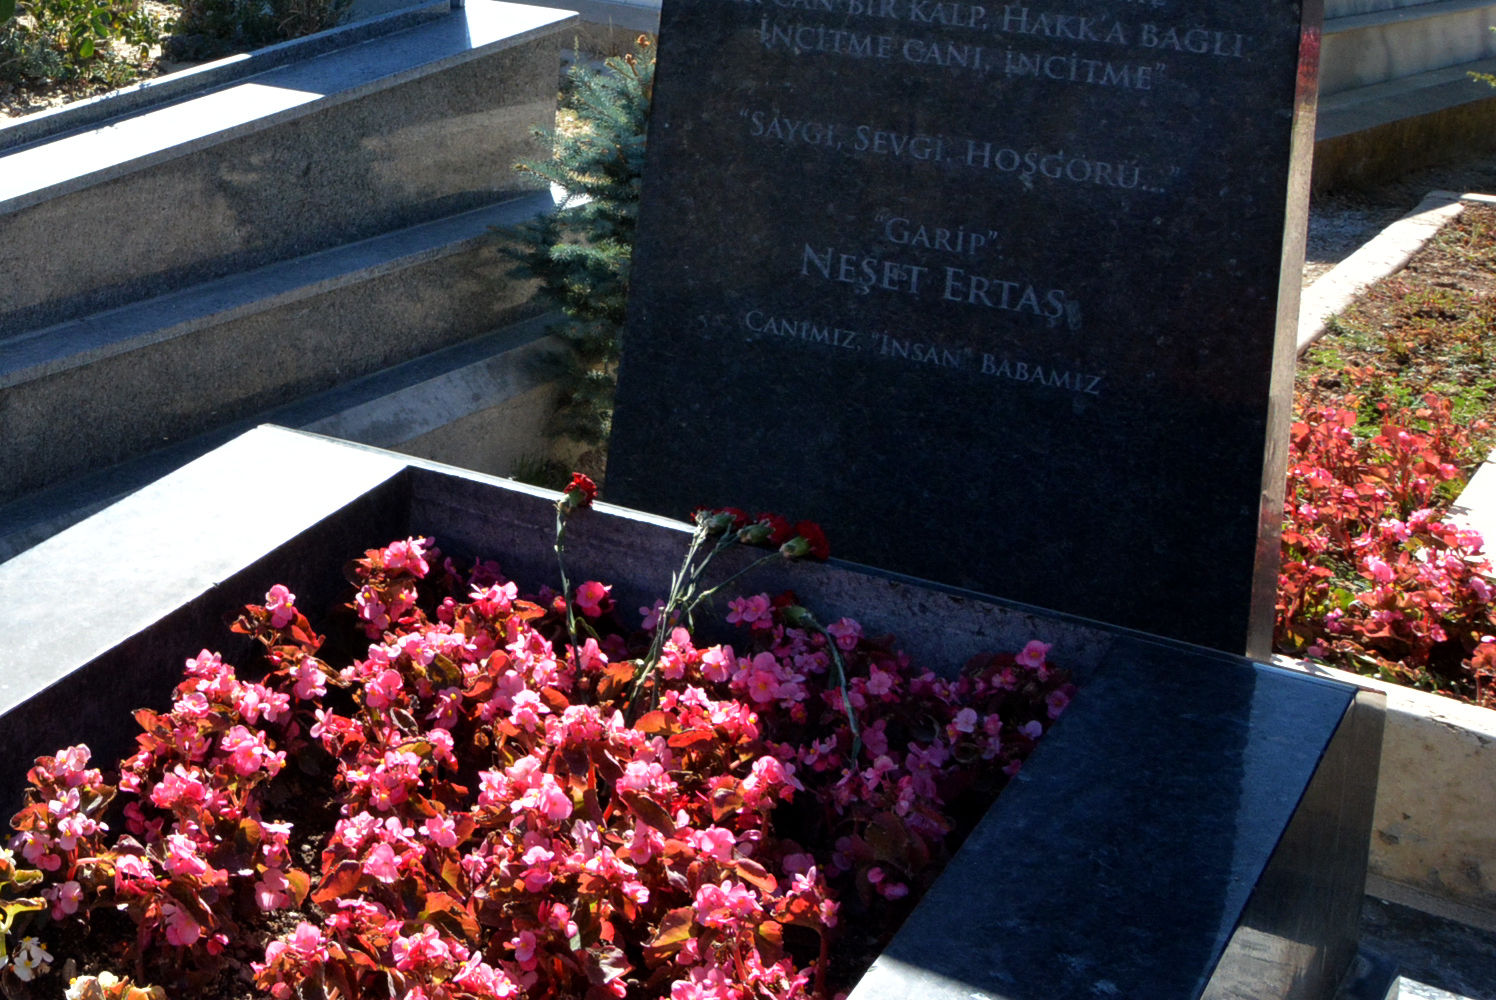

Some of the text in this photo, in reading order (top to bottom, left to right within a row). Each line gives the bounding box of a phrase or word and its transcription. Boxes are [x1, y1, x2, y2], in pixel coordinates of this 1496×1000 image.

[759, 13, 893, 59] İNCİTME
[902, 38, 991, 74] CANI,
[909, 0, 988, 32] KALP,
[1140, 19, 1245, 59] BAĞLI
[800, 242, 1067, 328] NEŞET ERTAŞ
[745, 309, 863, 353] CANIMIZ,
[979, 351, 1102, 396] BABAMIZ
